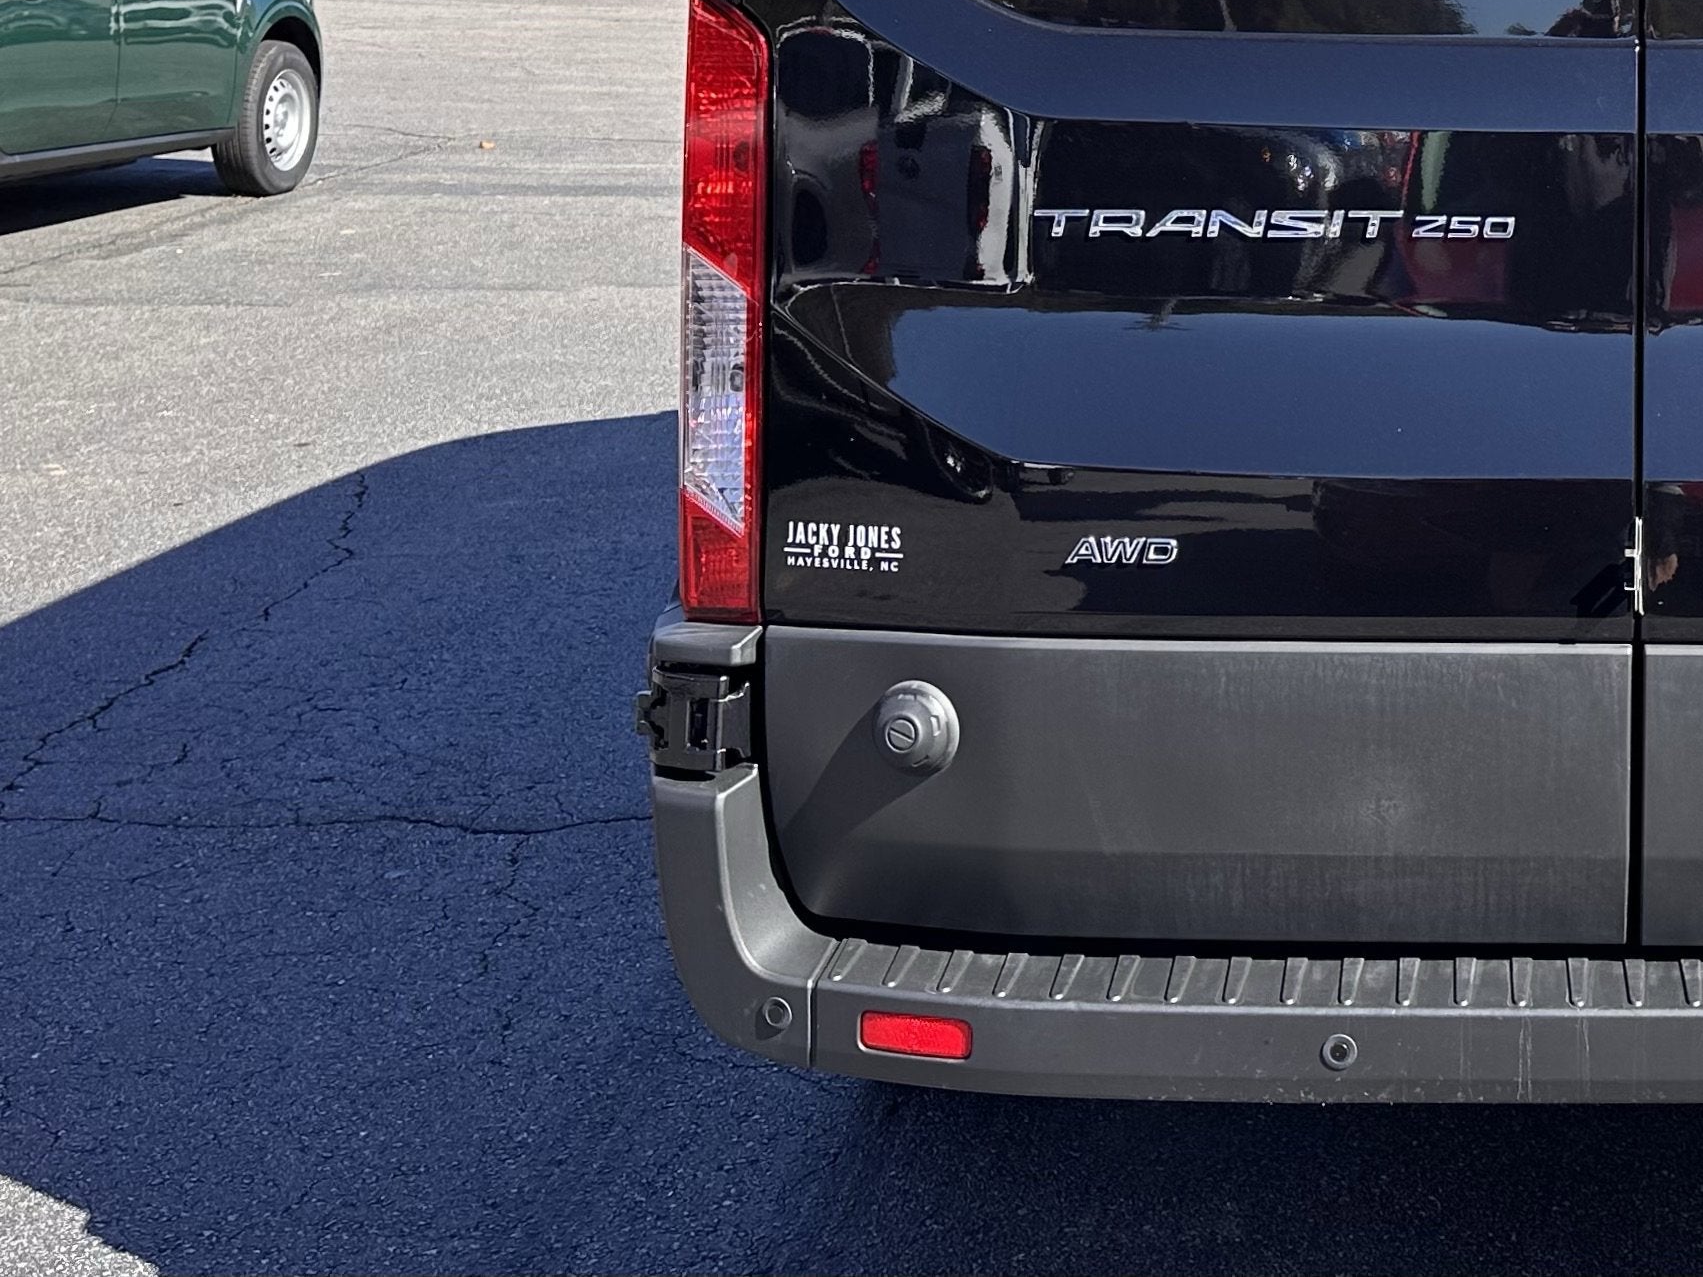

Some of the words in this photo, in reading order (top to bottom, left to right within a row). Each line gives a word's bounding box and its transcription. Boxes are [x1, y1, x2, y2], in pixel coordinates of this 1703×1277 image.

[1034, 208, 1404, 238] TRANSIT
[1412, 215, 1515, 239] 250
[786, 520, 841, 545] JACKY
[847, 524, 902, 550] JONES
[1064, 535, 1178, 564] AWD
[786, 555, 874, 572] HAYESVILLE,
[880, 560, 899, 572] NC
[813, 544, 872, 560] FORD
